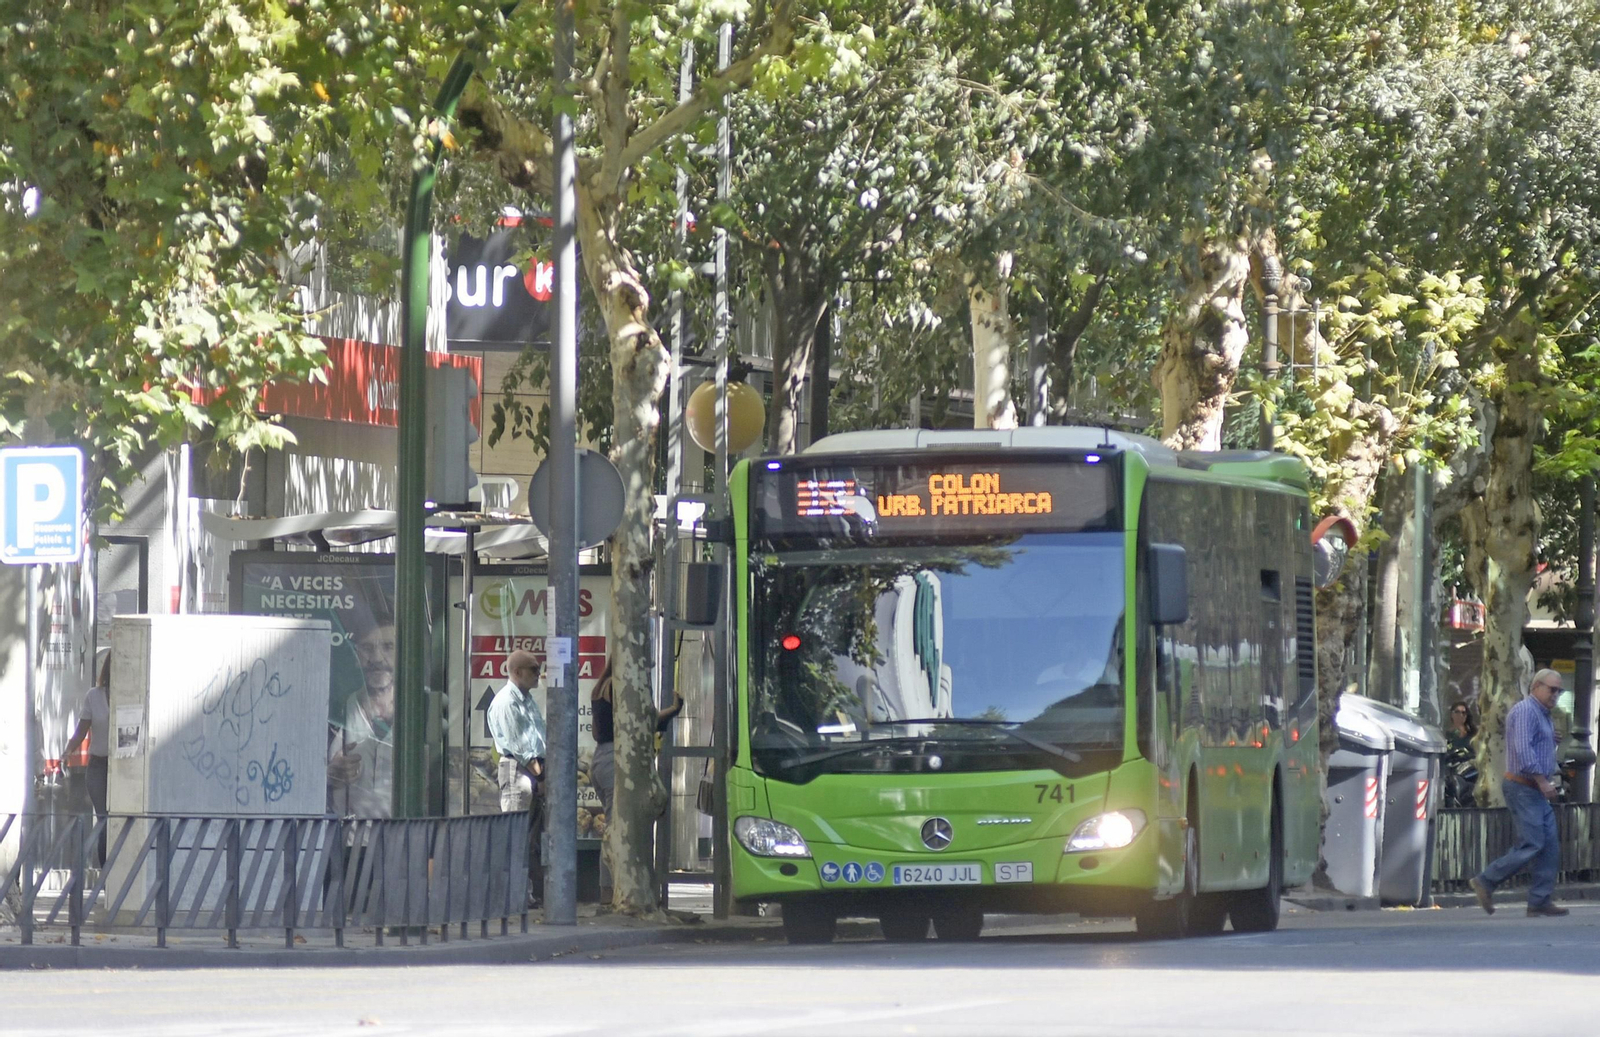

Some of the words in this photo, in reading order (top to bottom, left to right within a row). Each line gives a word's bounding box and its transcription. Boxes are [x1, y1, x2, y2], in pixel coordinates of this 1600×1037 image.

[928, 472, 1001, 495] COLON
[16, 462, 66, 549] P
[877, 495, 926, 517] URB.
[930, 492, 1053, 516] PATRIARCA
[317, 554, 360, 563] JCDecaux
[289, 576, 343, 590] VECES
[261, 594, 355, 609] NECESITAS
[515, 588, 594, 617] MS
[1034, 784, 1076, 804] 741
[903, 868, 943, 882] 6240
[948, 867, 978, 882] JJL
